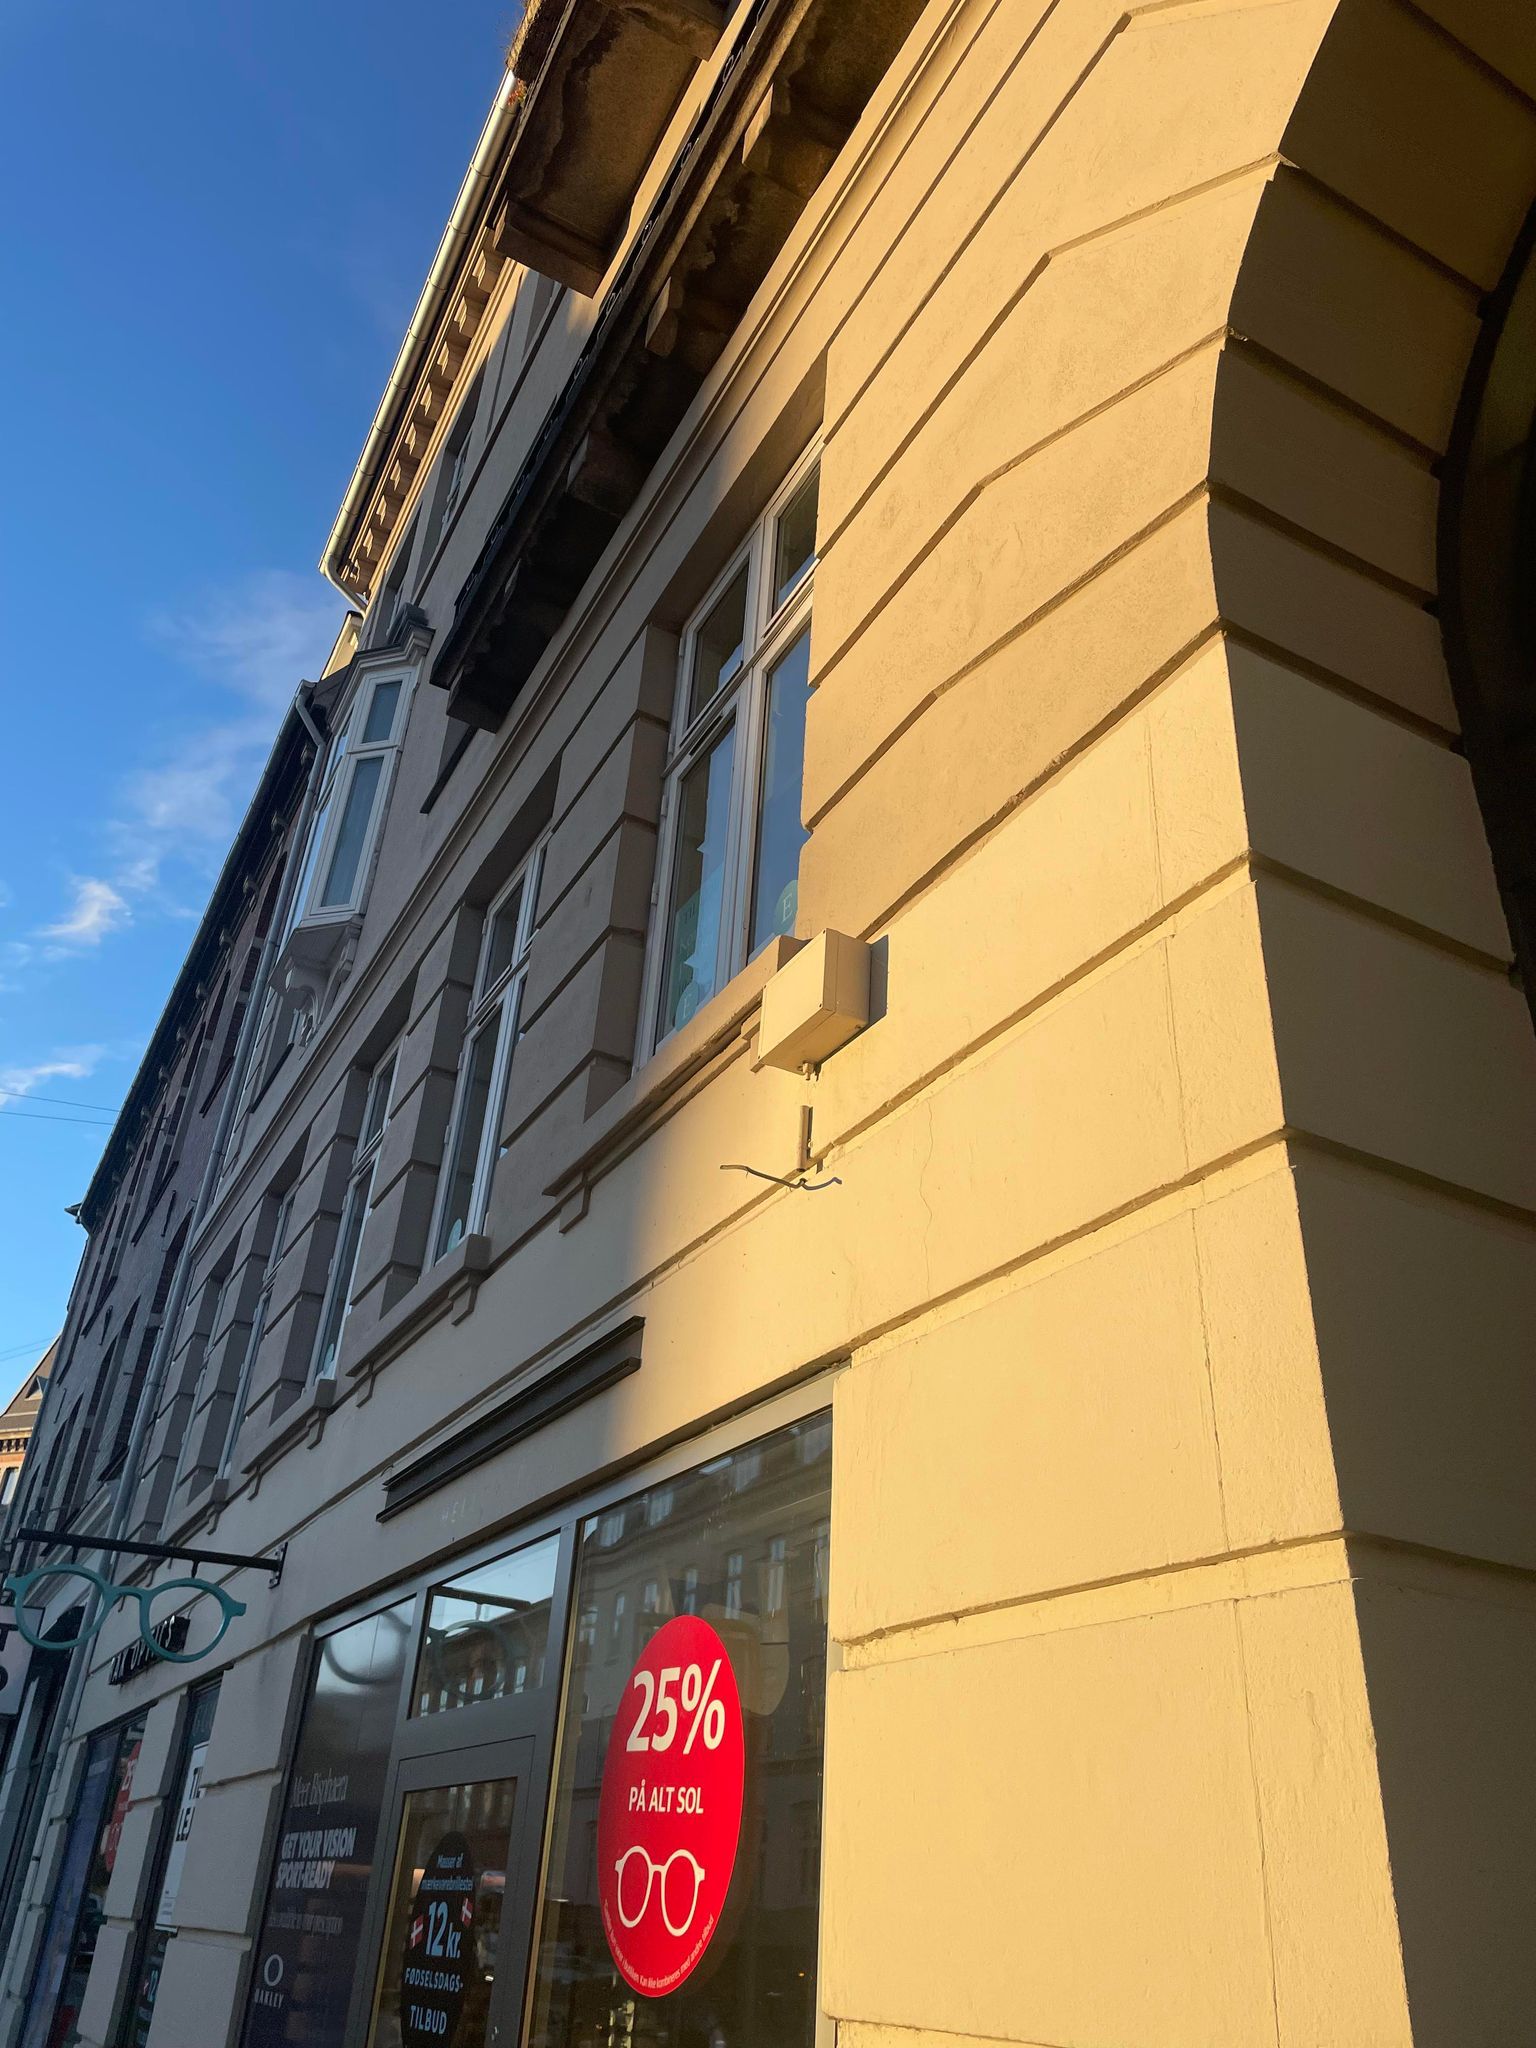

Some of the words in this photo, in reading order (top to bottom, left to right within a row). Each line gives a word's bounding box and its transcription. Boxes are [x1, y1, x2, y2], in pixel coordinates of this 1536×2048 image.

[626, 1658, 726, 1755] 25%
[628, 1778, 647, 1813] PÅ
[648, 1786, 676, 1813] ALT
[676, 1786, 704, 1815] SOL
[281, 1832, 300, 1860] GET
[298, 1829, 324, 1859] YOUR
[322, 1826, 358, 1858] VISION
[275, 1859, 336, 1889] SPORT-READY
[425, 1901, 449, 1957] 12
[446, 1922, 462, 1959] kr.
[404, 1967, 464, 1993] FØDSELSDAGS-
[410, 2004, 448, 2035] TILBUD
